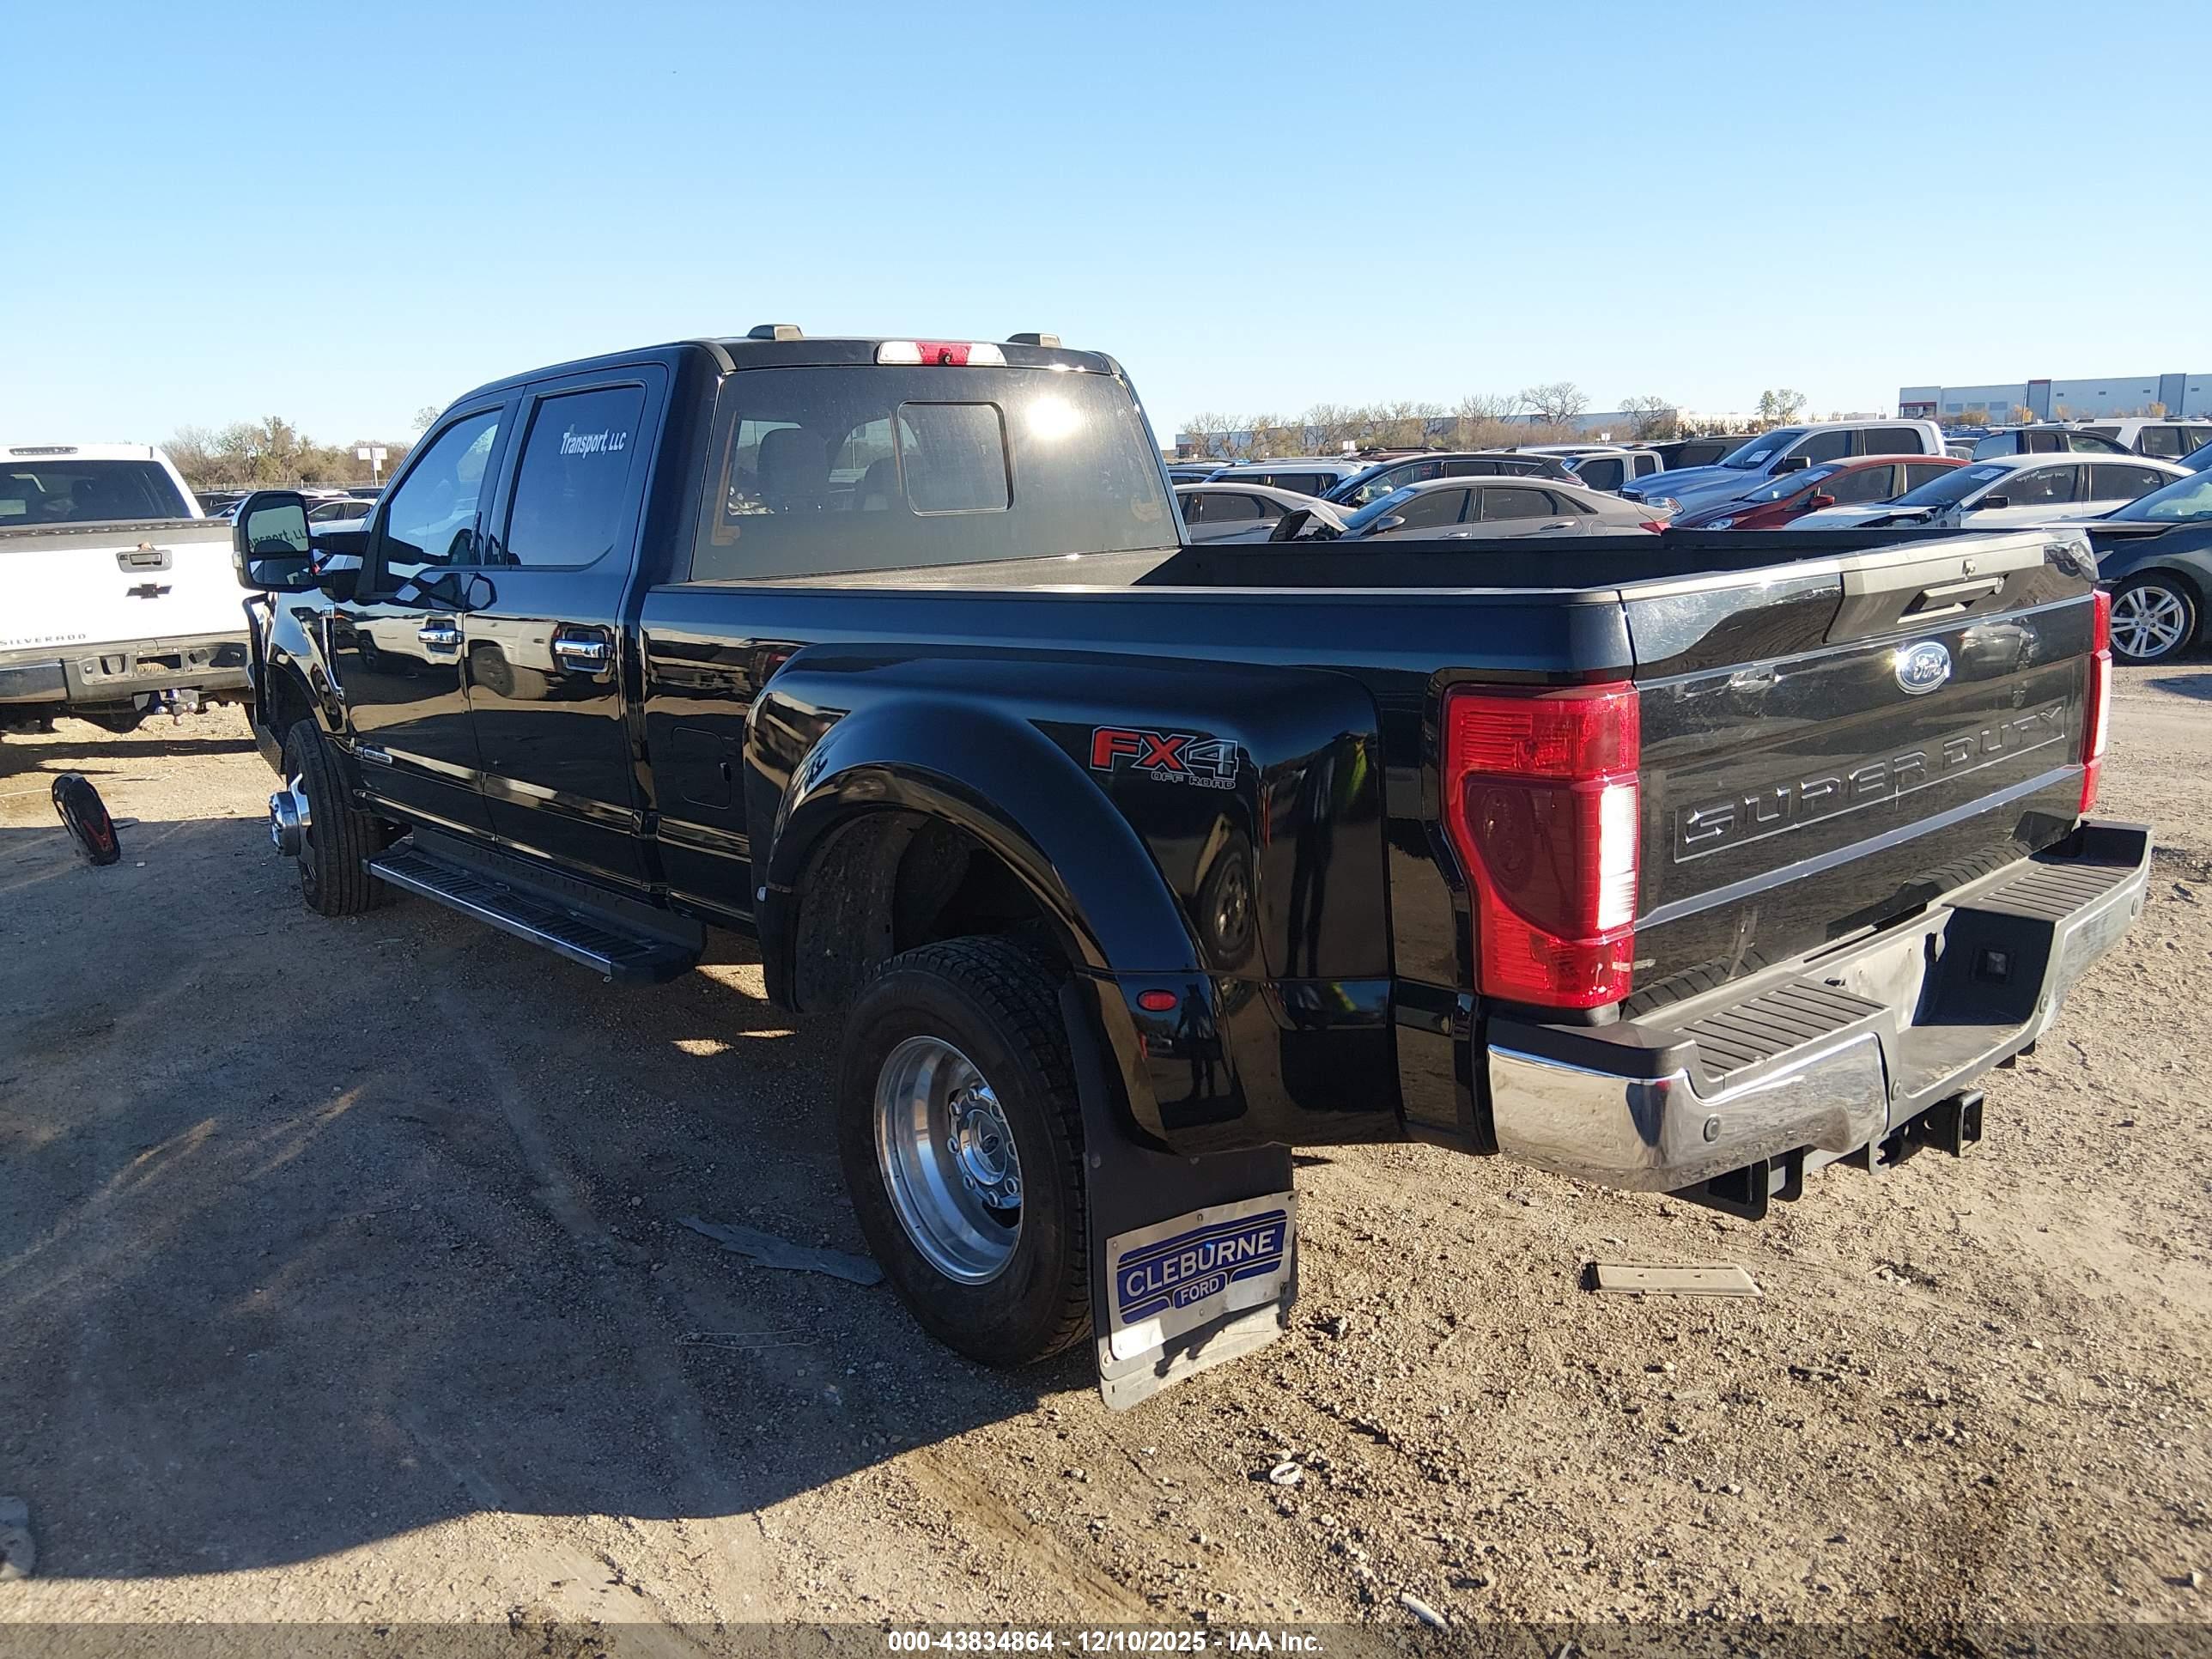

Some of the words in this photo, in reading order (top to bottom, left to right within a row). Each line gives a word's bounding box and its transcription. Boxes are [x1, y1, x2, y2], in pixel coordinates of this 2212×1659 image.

[560, 428, 608, 459] Transport,
[608, 432, 627, 451] LLC
[1090, 726, 1239, 781] FX4
[1685, 750, 1928, 844] SUPER
[1942, 705, 2063, 771] DUTY
[1151, 771, 1184, 783] OFF
[1188, 775, 1237, 790] ROAD
[1126, 1229, 1276, 1297] CLEBURNE
[1180, 1277, 1220, 1305] FORD
